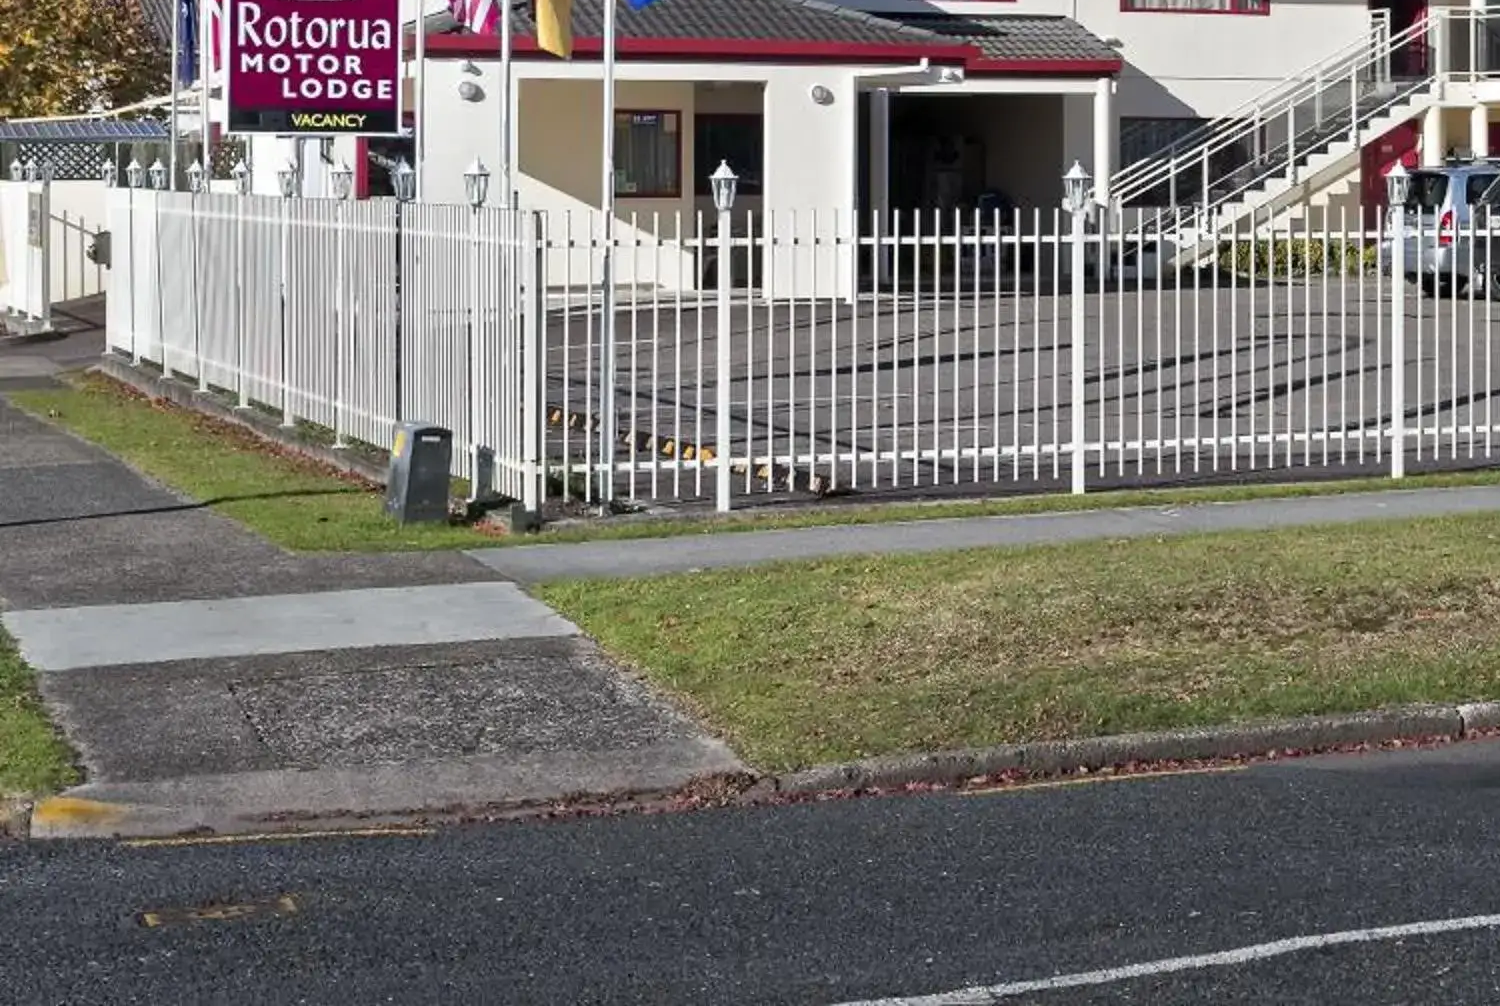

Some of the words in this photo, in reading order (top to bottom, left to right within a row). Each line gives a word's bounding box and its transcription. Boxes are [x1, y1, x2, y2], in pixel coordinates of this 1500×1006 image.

[237, 1, 391, 49] Rotorua
[240, 53, 363, 75] MOTOR
[282, 78, 393, 99] LODGE
[291, 113, 367, 127] VACANCY
